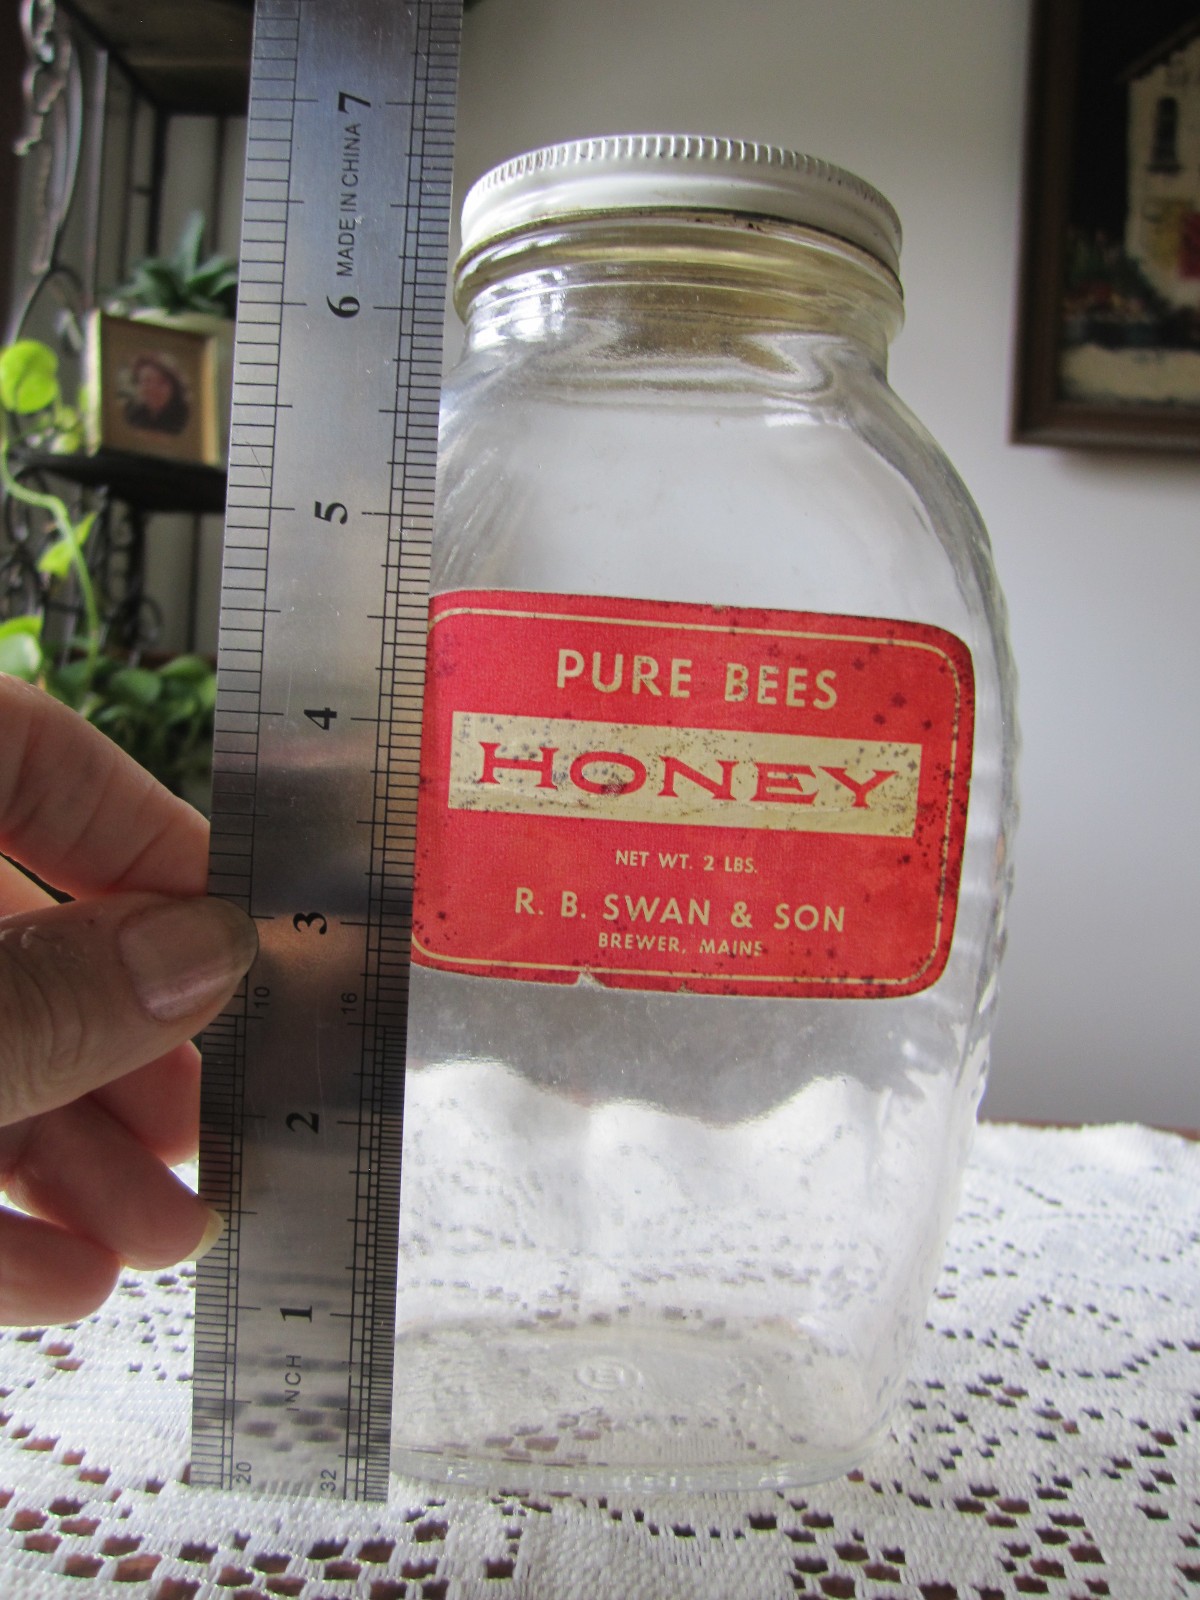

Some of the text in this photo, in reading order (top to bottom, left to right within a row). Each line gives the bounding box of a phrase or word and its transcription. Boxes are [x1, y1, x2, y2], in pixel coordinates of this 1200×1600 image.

[338, 91, 372, 113] 7
[337, 123, 361, 277] MADE IN CHINA
[326, 295, 360, 319] 6
[314, 500, 348, 525] 5
[557, 649, 838, 710] PURE BEES
[303, 707, 337, 731] 4
[476, 741, 896, 808] HONEY
[615, 849, 758, 874] NET WT. 2 LBS.
[514, 886, 845, 933] R. B. SWAN & SON
[293, 911, 327, 935] 3
[598, 932, 687, 954] BREWER,
[253, 986, 271, 1009] 10
[340, 992, 358, 1015] 16
[285, 1111, 319, 1134] 2
[280, 1305, 312, 1323] 1
[284, 1354, 303, 1412] INCH
[234, 1461, 252, 1485] 20
[320, 1468, 338, 1493] 32
